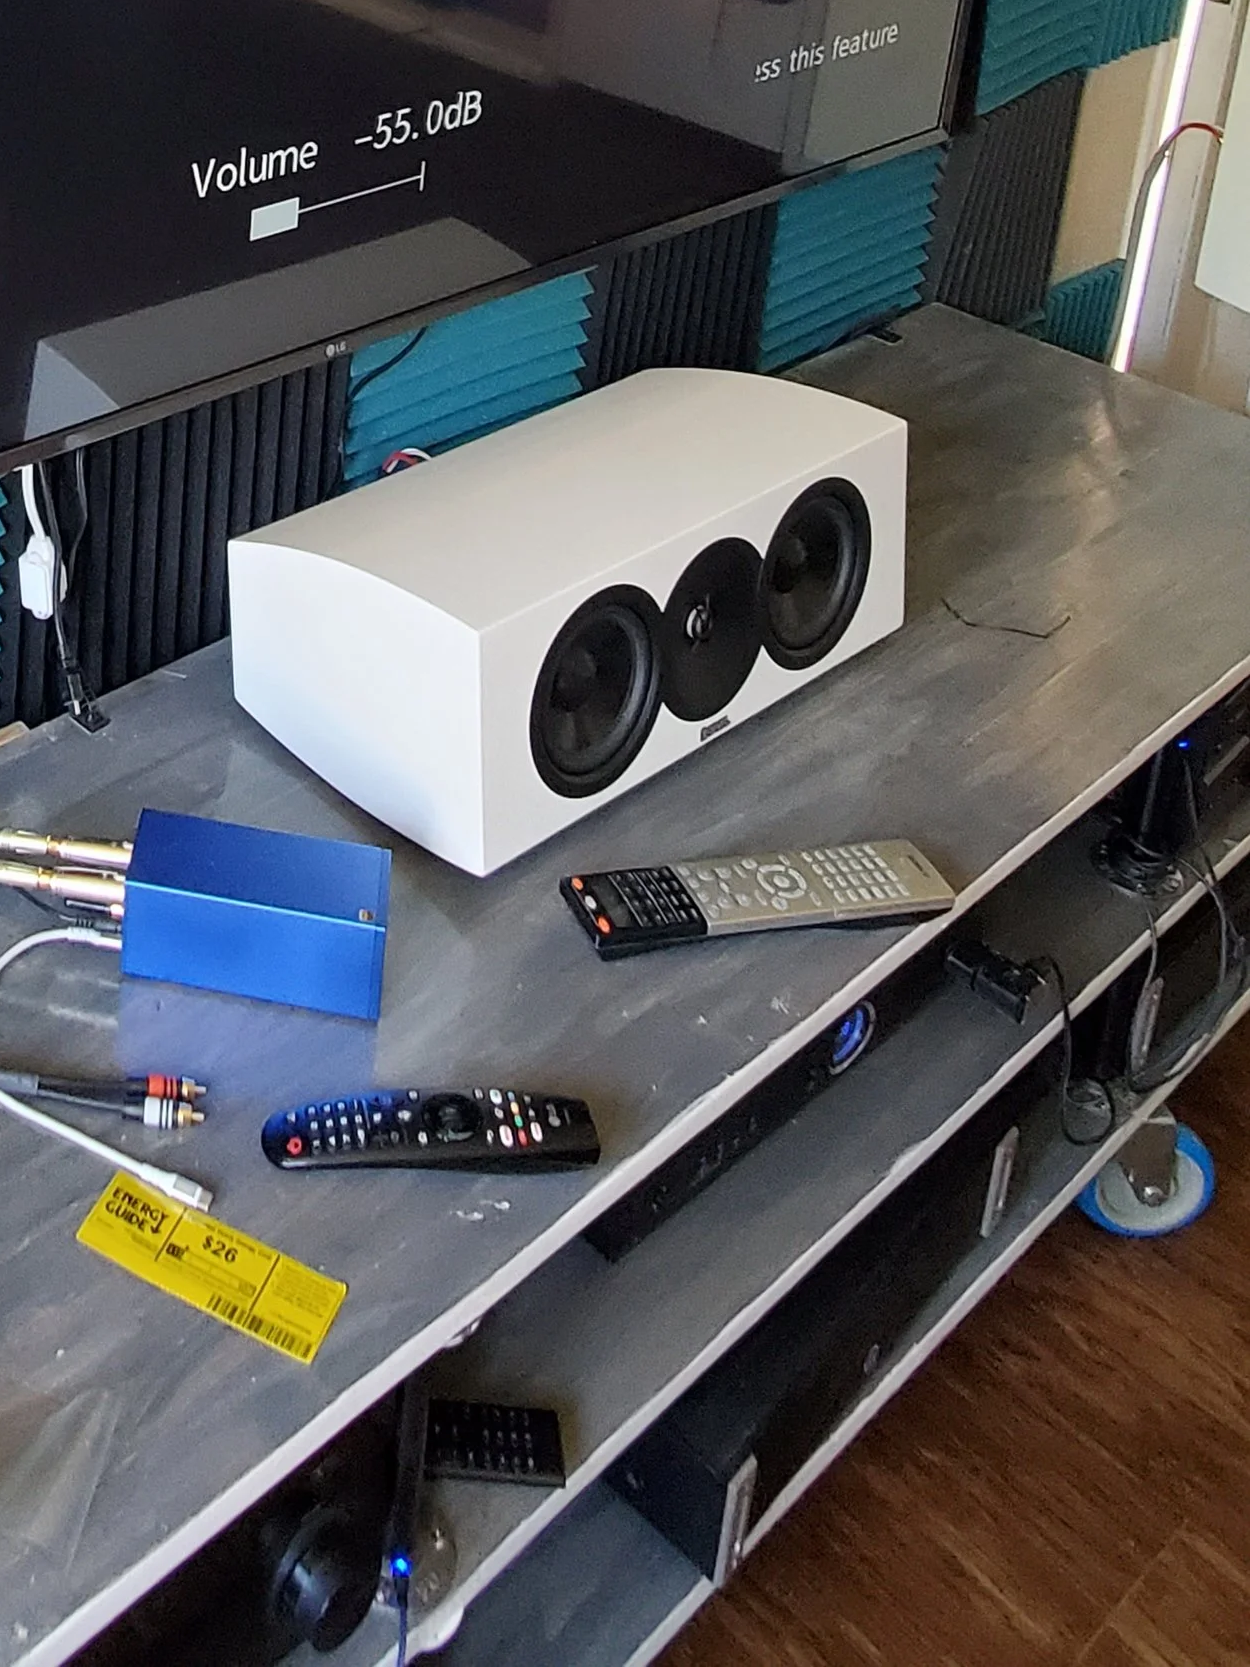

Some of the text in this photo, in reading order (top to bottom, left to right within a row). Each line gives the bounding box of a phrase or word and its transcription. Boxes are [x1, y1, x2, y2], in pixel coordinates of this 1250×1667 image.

[790, 42, 824, 72] this
[831, 24, 899, 60] feature
[192, 141, 318, 198] Volume
[105, 1200, 146, 1233] GUIDE
[112, 1187, 168, 1234] ENERGY
[202, 1235, 238, 1263] $26
